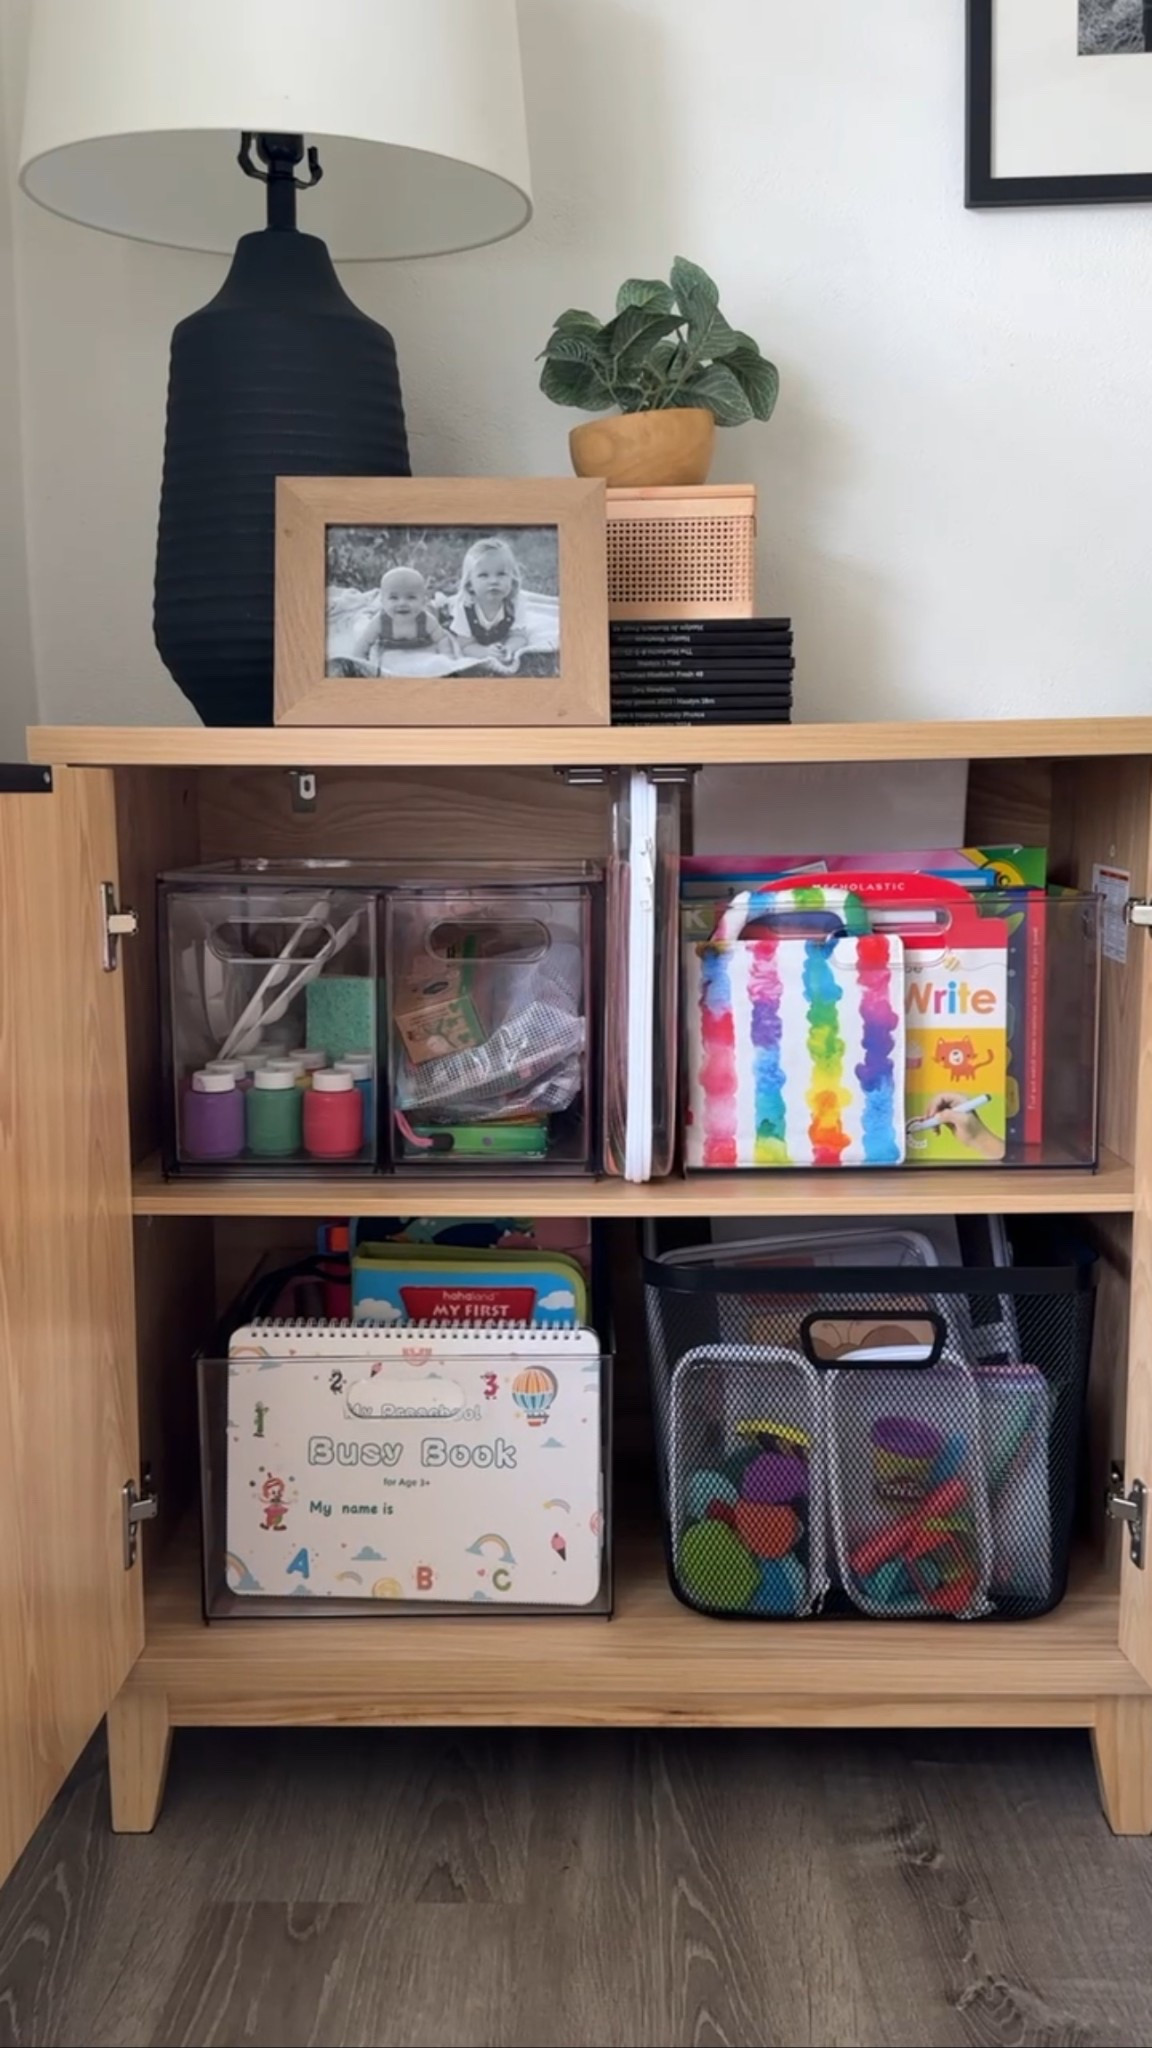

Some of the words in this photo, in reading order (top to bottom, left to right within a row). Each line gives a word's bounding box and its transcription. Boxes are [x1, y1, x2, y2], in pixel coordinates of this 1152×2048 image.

[442, 1290, 495, 1301] hahaland
[433, 1304, 460, 1316] MY
[465, 1304, 510, 1316] FIRST
[481, 1371, 499, 1400] 3
[308, 1435, 404, 1467] Busy
[420, 1437, 518, 1469] Book
[383, 1477, 397, 1487] for
[398, 1477, 417, 1489] Age
[309, 1500, 332, 1517] My
[342, 1503, 378, 1515] name
[383, 1502, 394, 1515] is
[286, 1547, 310, 1580] A
[416, 1566, 434, 1591] B
[492, 1568, 512, 1592] C
